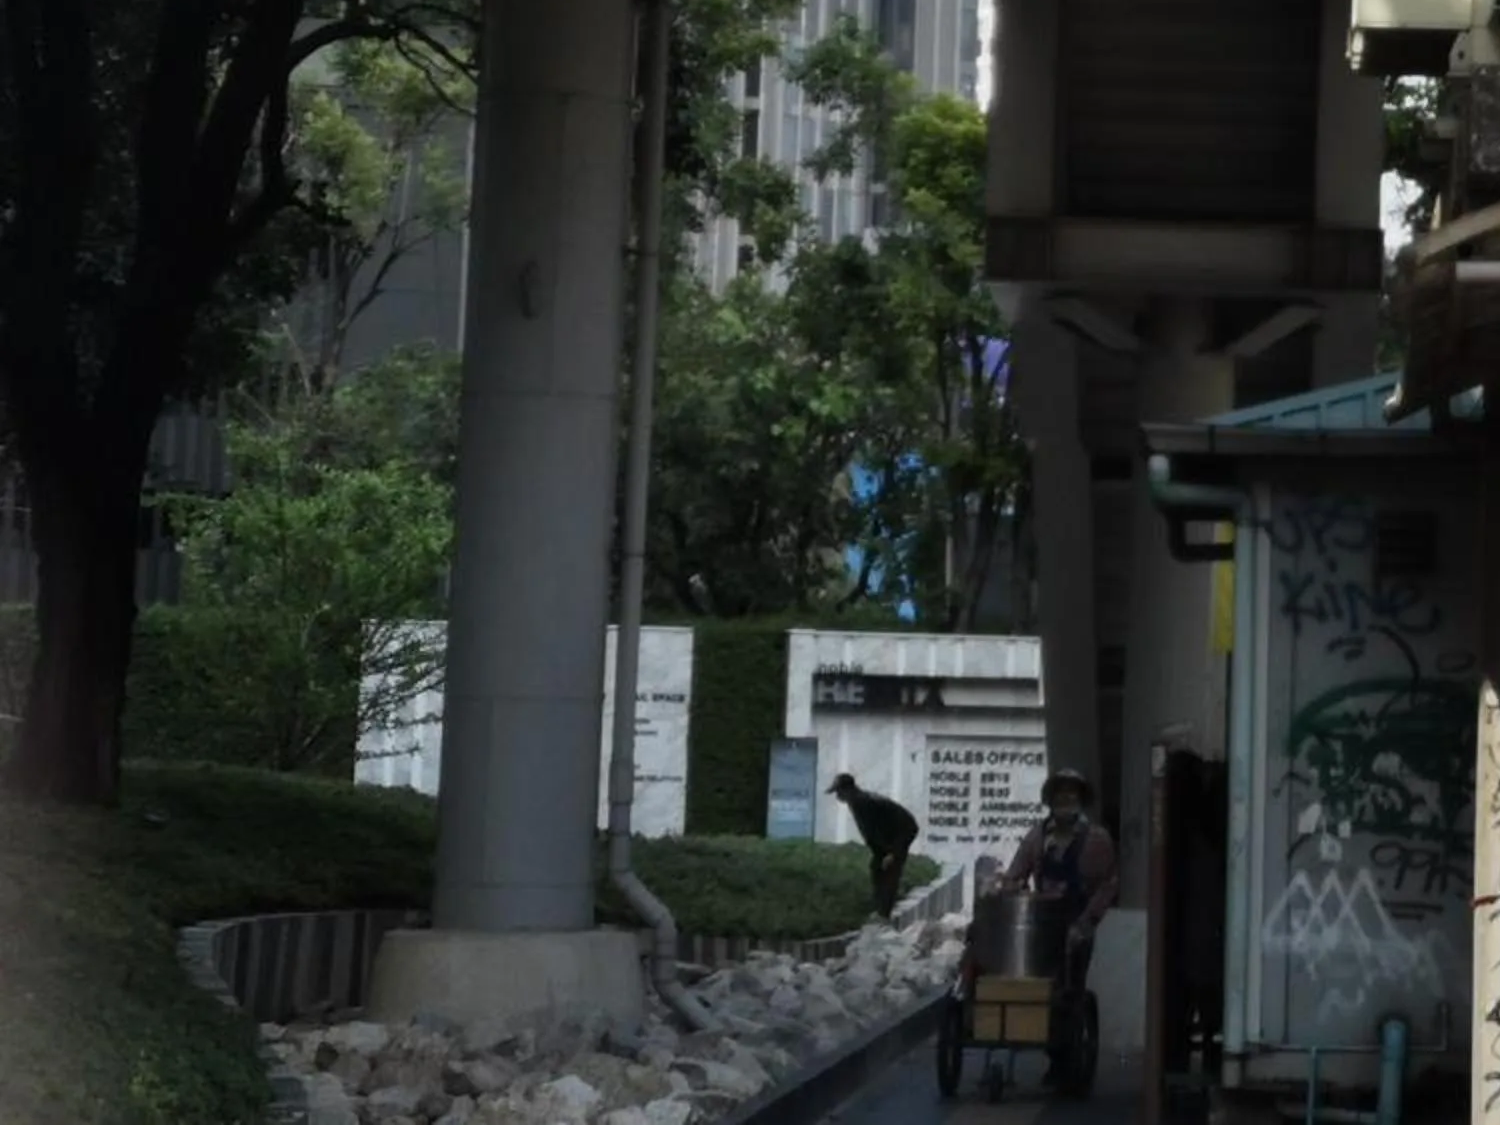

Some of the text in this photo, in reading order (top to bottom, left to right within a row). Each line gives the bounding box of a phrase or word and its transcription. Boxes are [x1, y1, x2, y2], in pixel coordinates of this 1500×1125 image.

[931, 750, 1044, 766] SALES OFFICE
[929, 771, 970, 783] NOBLE
[929, 786, 970, 798] NOBLE
[929, 801, 969, 813] NOBLE
[928, 816, 969, 827] NOBLE
